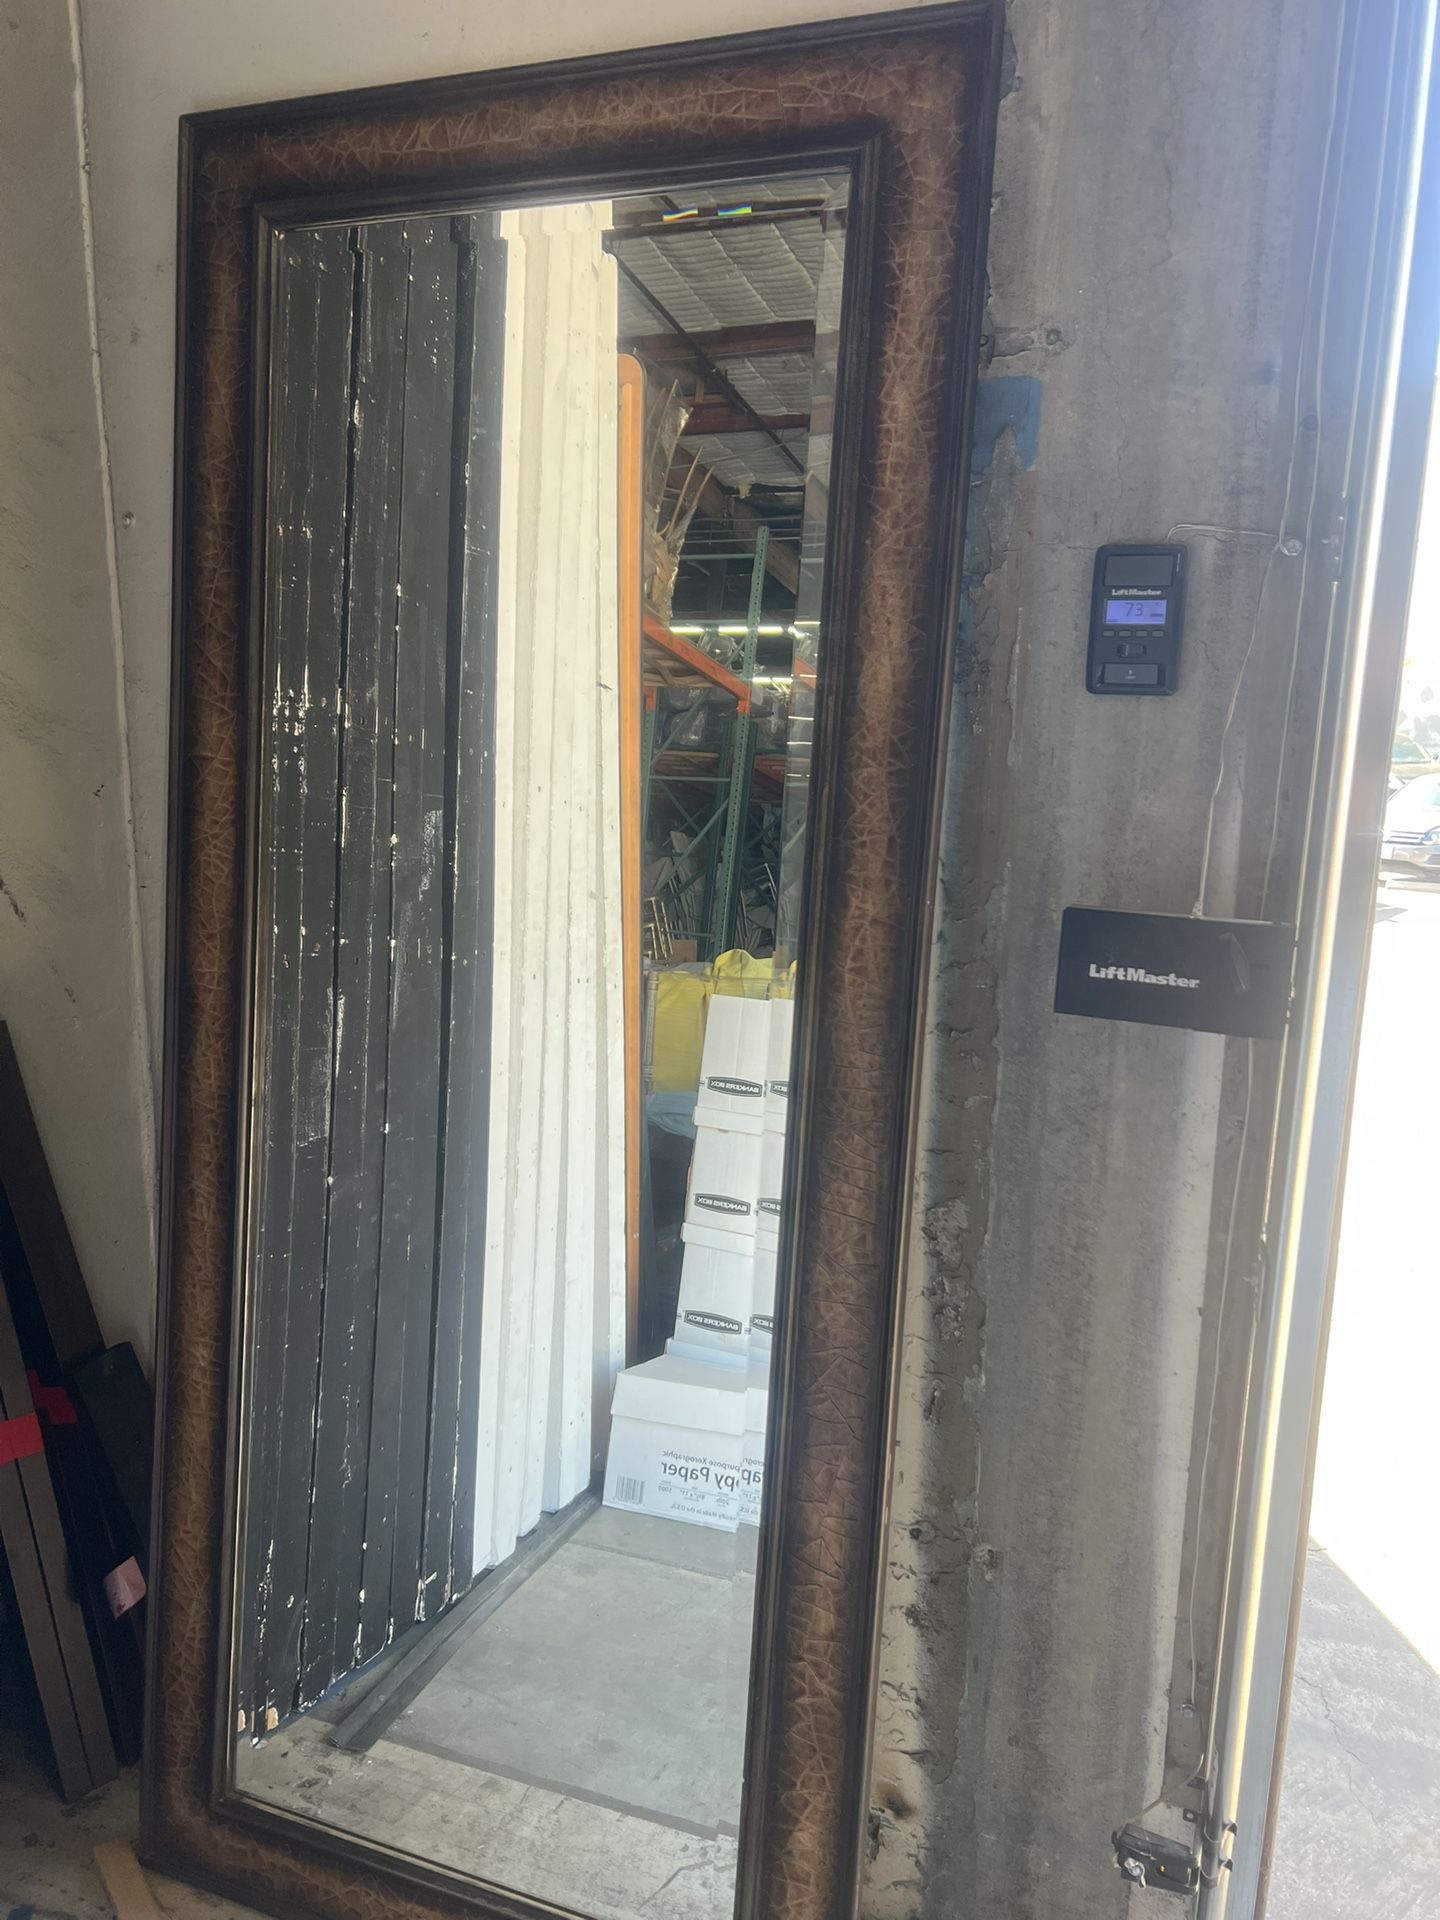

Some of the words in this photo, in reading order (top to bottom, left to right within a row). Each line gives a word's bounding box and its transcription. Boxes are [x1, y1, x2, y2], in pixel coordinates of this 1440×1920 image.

[1112, 588, 1162, 596] LiftMaster
[1125, 602, 1144, 617] 73
[1089, 963, 1200, 988] LiftMaster
